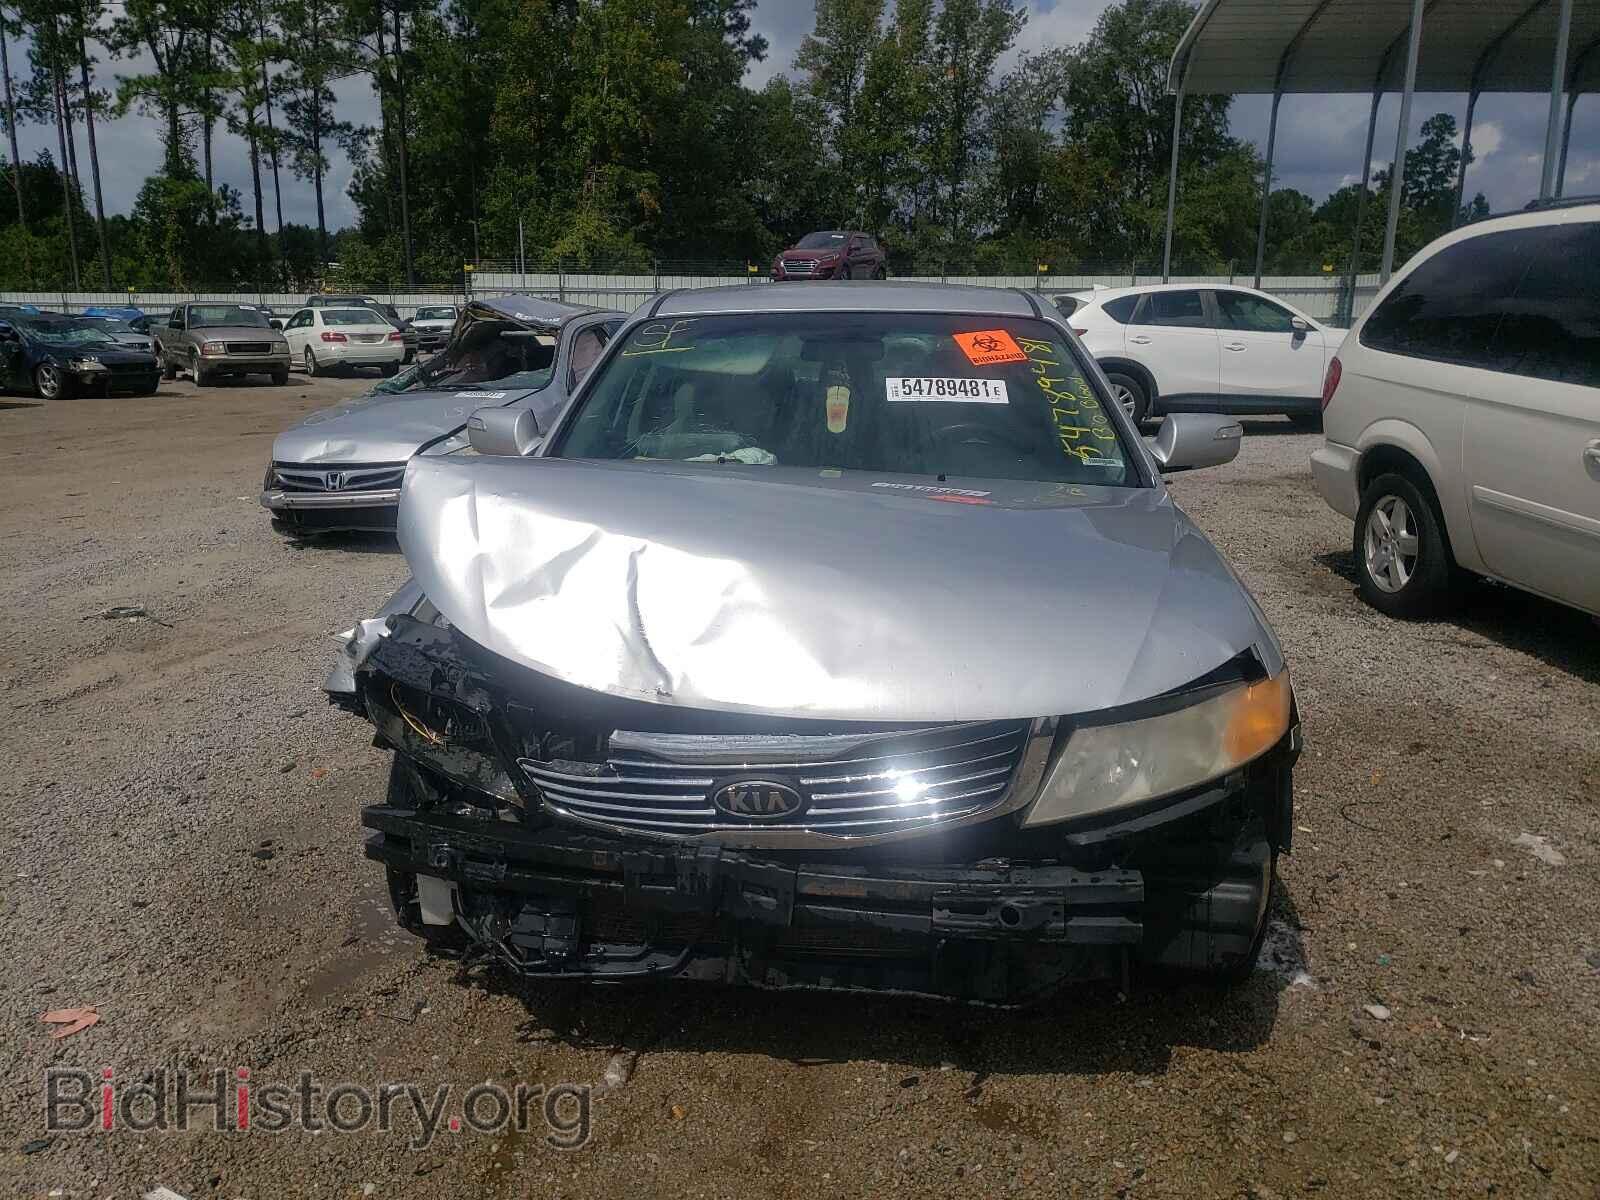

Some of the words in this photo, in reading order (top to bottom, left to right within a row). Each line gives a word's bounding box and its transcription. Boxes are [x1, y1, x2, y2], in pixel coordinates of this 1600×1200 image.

[972, 352, 1025, 363] BIOHAZARD
[901, 379, 990, 397] 54789481
[993, 386, 1001, 396] E
[727, 786, 787, 811] KIA
